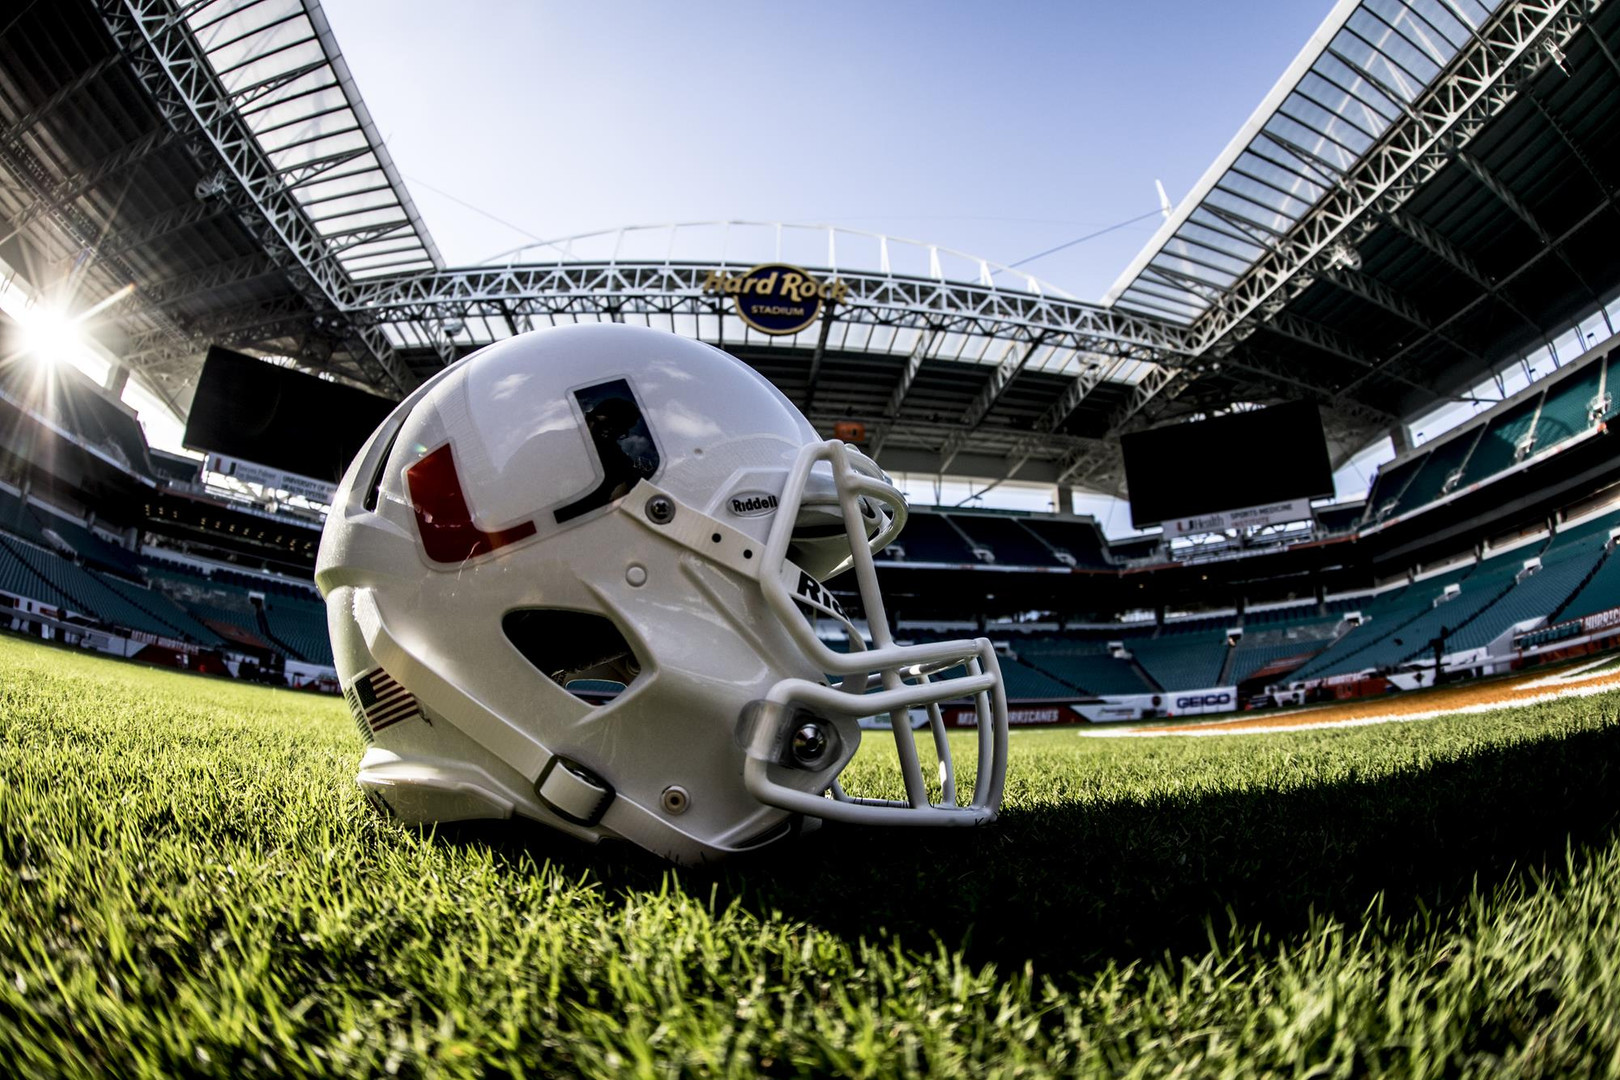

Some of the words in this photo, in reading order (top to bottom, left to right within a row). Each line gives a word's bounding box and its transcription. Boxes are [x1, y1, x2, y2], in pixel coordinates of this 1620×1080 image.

[702, 269, 779, 295] Hard
[780, 272, 850, 305] Rock
[751, 304, 805, 316] STADIUM
[732, 495, 778, 512] Riddell
[1230, 509, 1258, 520] SPORTS
[1259, 503, 1293, 516] MEDICINE
[1176, 693, 1231, 709] GEICO
